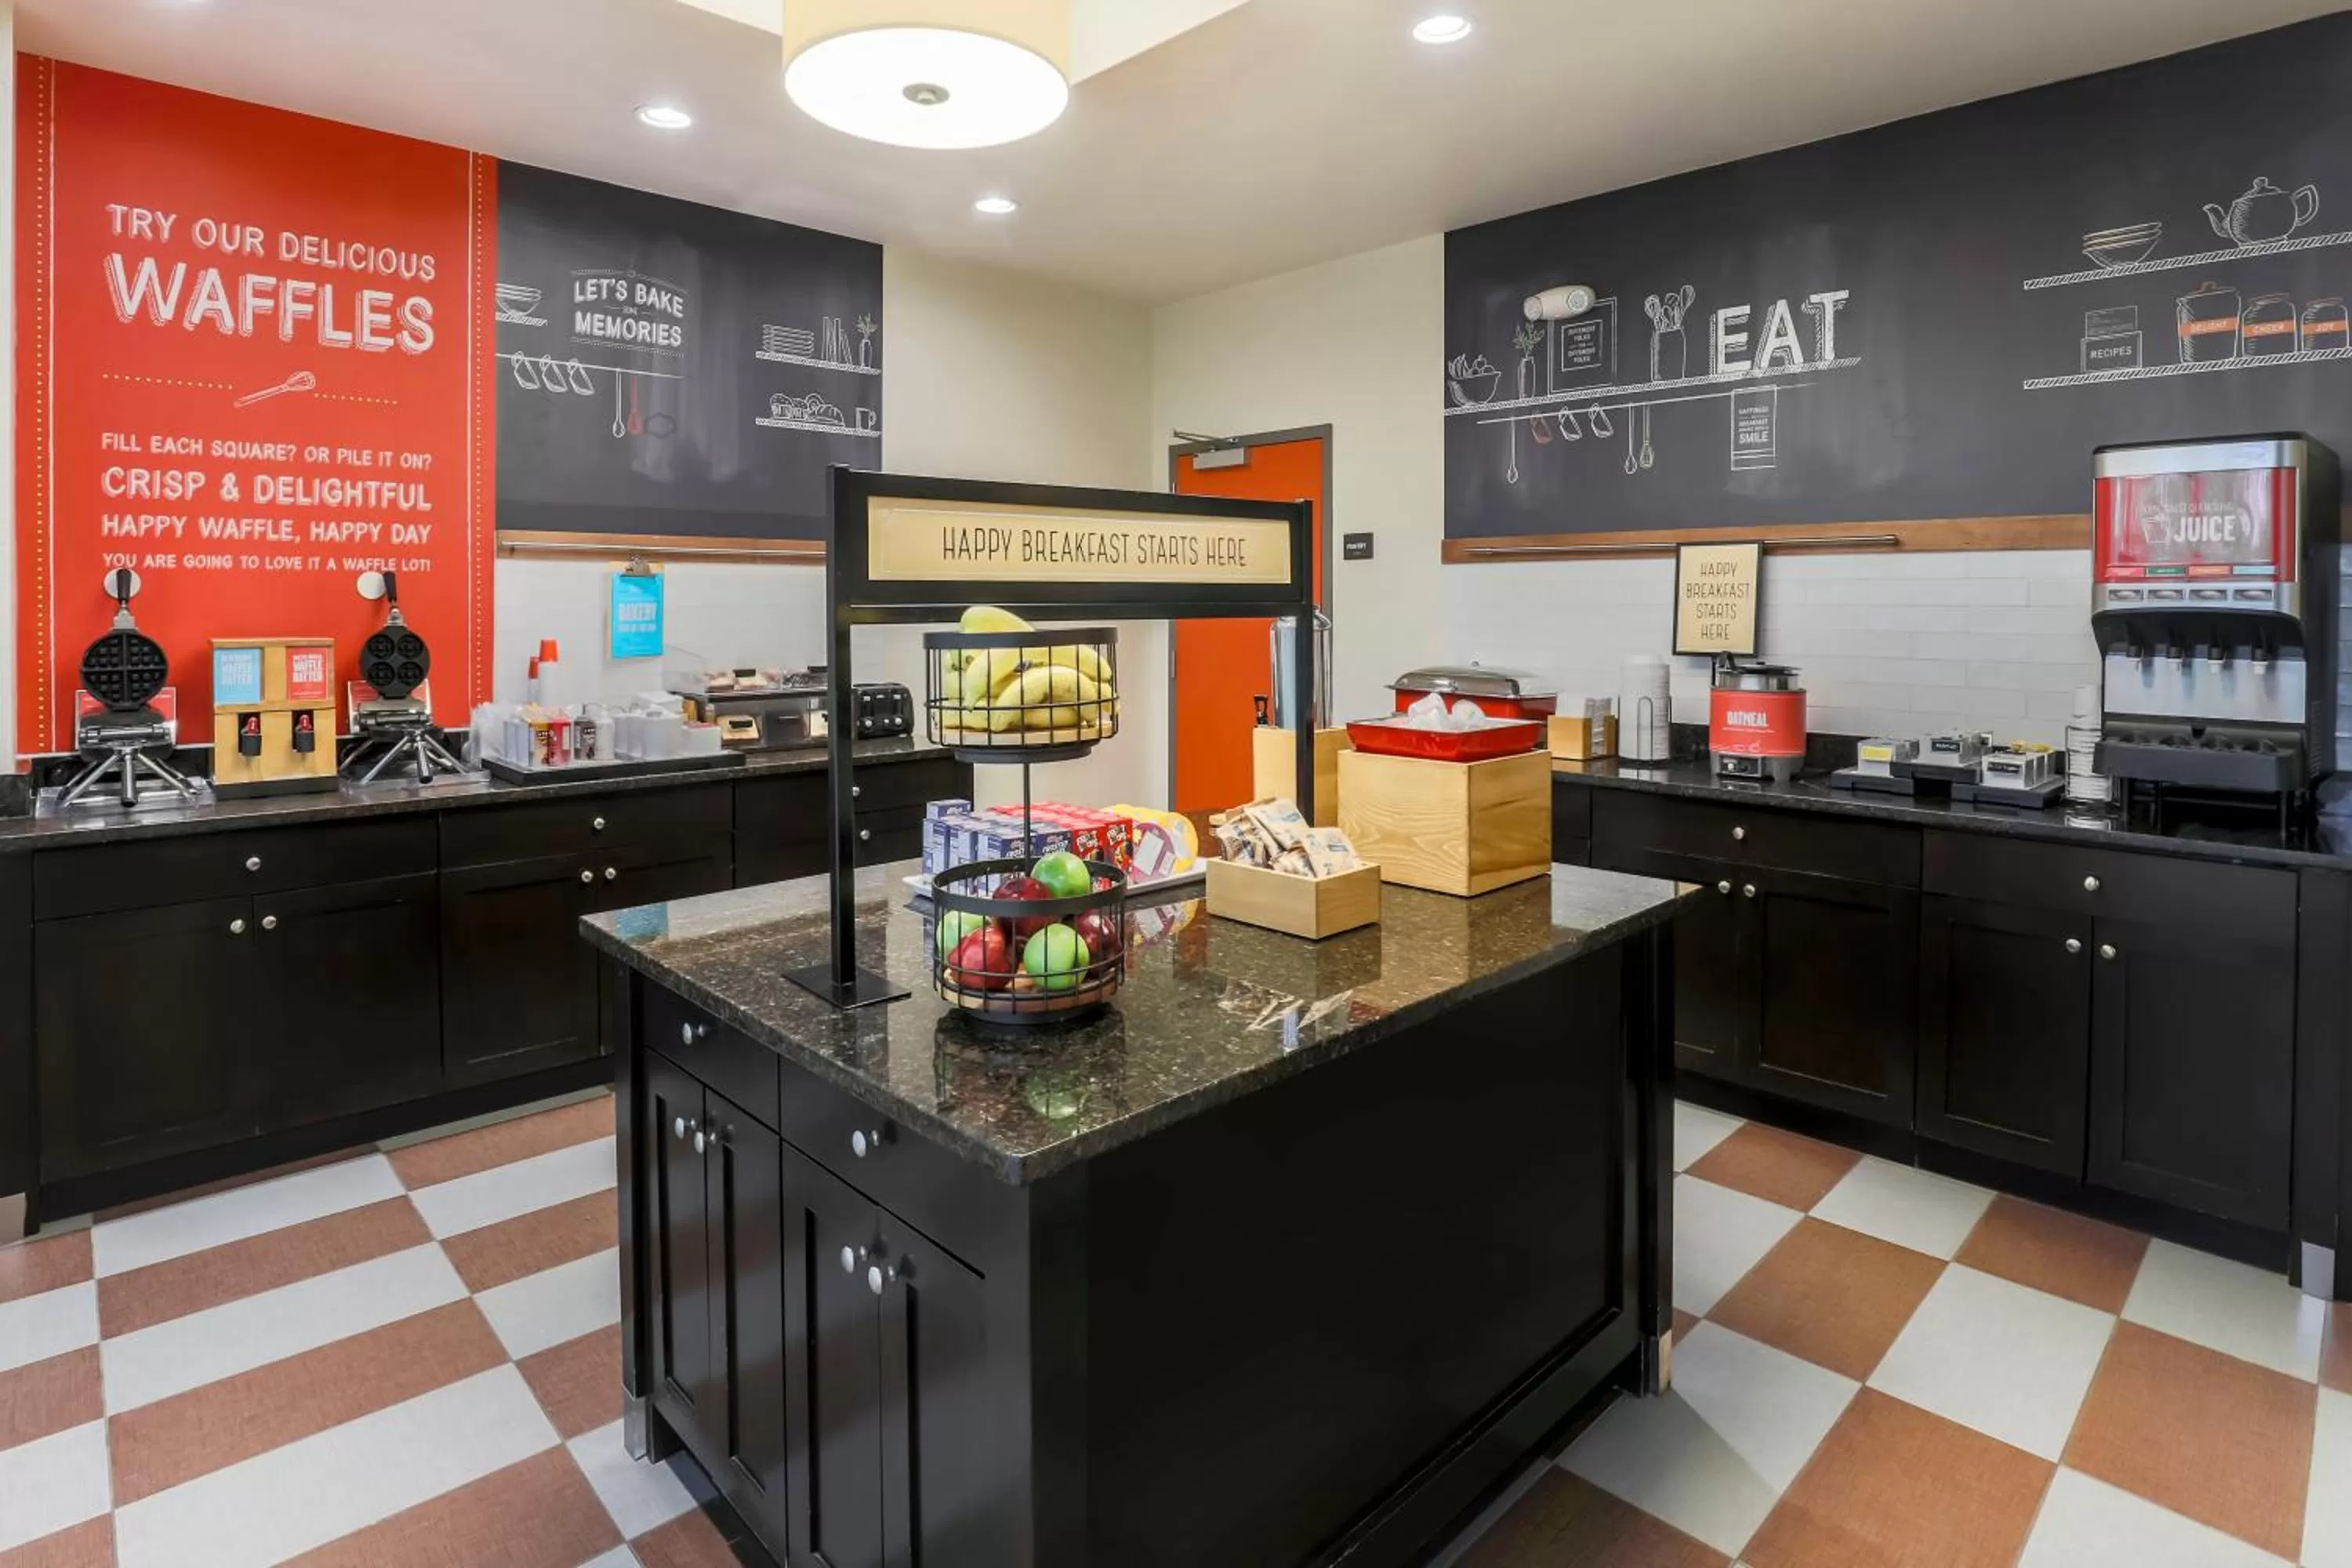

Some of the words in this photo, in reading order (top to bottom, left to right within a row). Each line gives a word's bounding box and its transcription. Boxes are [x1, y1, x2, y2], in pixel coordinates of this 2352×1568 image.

[104, 203, 176, 241] TRY
[192, 219, 264, 256] OUR
[280, 231, 435, 281] DELICIOUS
[103, 252, 434, 354] WAFFLES
[574, 278, 627, 303] LET'S
[634, 282, 684, 318] BAKE
[575, 310, 681, 347] MEMORIES
[1710, 289, 1850, 376] EAT
[2090, 346, 2132, 358] RECIPES
[102, 432, 141, 452] FILL
[150, 434, 203, 456] EACH
[211, 441, 296, 462] SQUARE?
[305, 446, 330, 463] OR
[337, 448, 372, 466] PILE
[379, 451, 394, 467] IT
[400, 452, 432, 470] ON?
[1739, 431, 1769, 444] SMILE
[103, 466, 206, 500] CRISP
[220, 473, 239, 502] &
[254, 474, 432, 511] DELIGHTFUL
[102, 514, 187, 538] HAPPY
[199, 517, 300, 544] WAFFLE,
[310, 521, 384, 543] HAPPY
[392, 523, 432, 546] DAY
[2173, 515, 2238, 543] JUICE
[942, 526, 1012, 560] HAPPY
[1022, 529, 1129, 564] BREAKFAST
[1138, 534, 1198, 566] STARTS
[1206, 538, 1247, 567] HERE
[103, 553, 136, 568] YOU
[144, 554, 176, 568] ARE
[183, 555, 233, 569] GOING
[240, 556, 259, 569] TO
[265, 556, 301, 570] LOVE
[308, 556, 320, 570] IT
[326, 557, 337, 570] A
[343, 557, 396, 572] WAFFLE
[401, 559, 431, 572] LOT!
[1700, 561, 1737, 577] HAPPY
[1686, 583, 1750, 600] BREAKFAST
[1696, 603, 1737, 619] STARTS
[1700, 623, 1730, 641] HERE
[1727, 710, 1769, 728] OATMEAL
